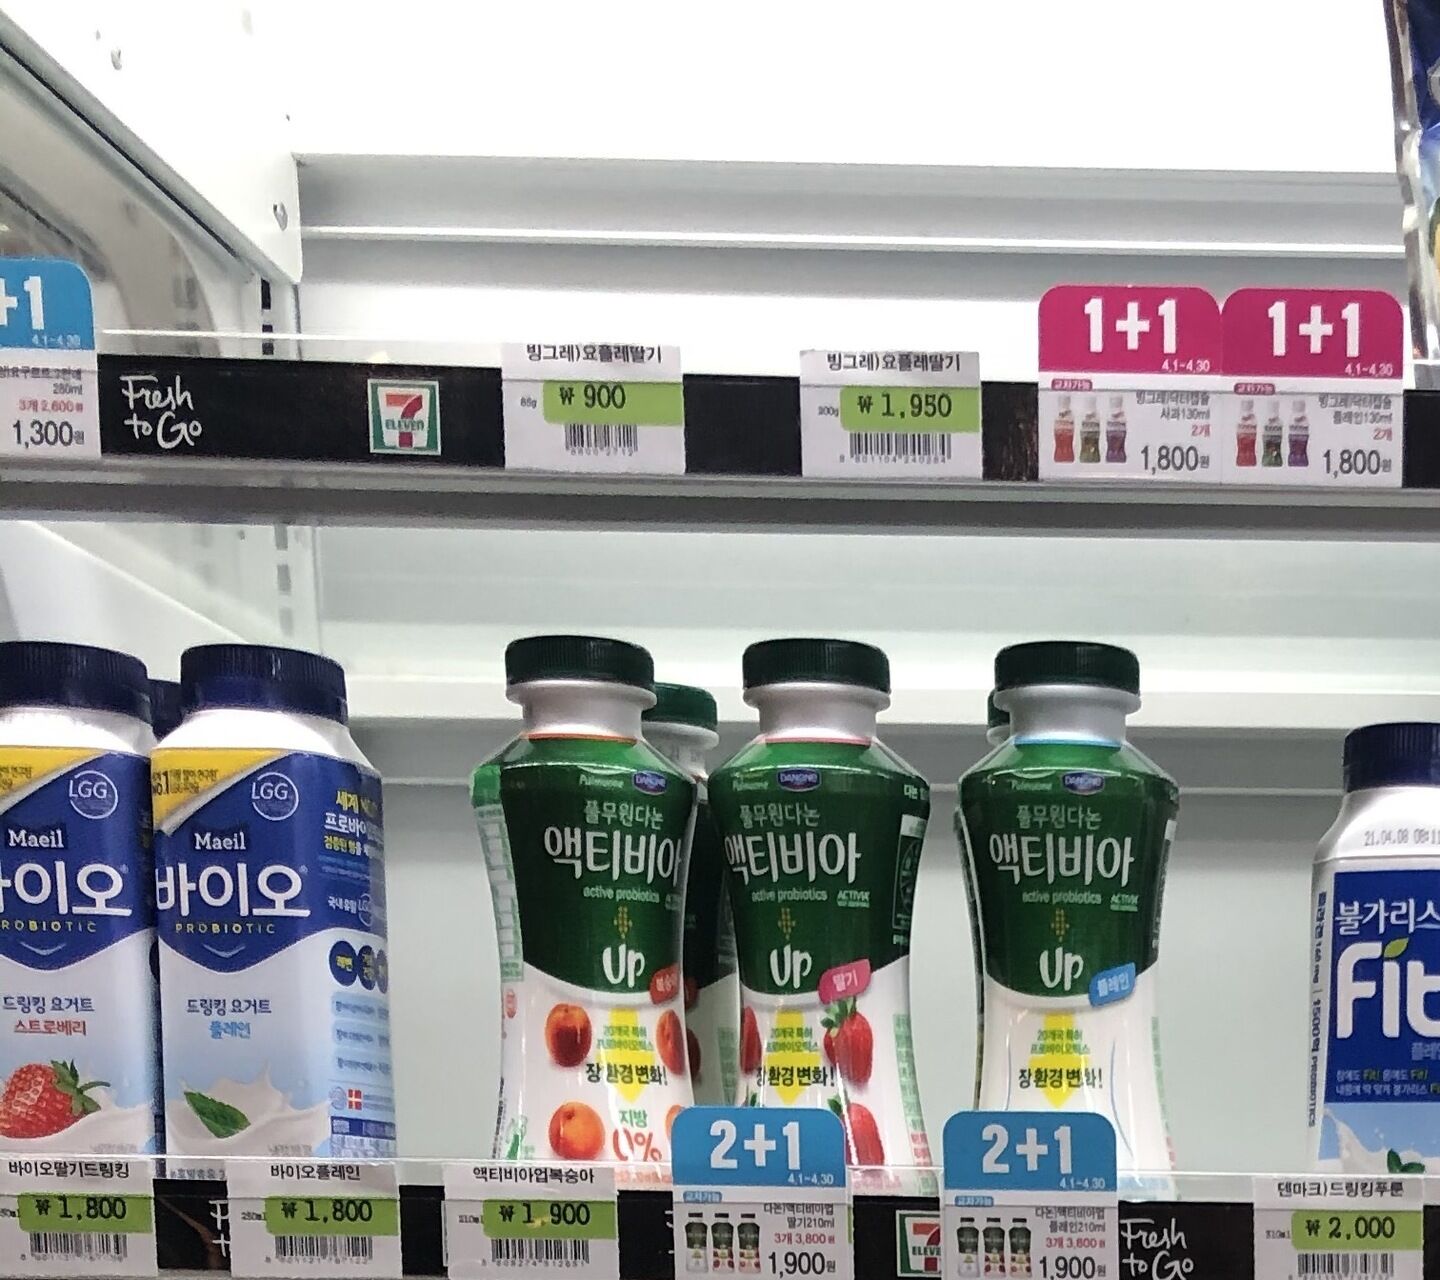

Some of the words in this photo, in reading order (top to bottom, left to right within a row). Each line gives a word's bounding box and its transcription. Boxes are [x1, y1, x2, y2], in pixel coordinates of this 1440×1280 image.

[1084, 298, 1177, 354] 1+1
[1267, 302, 1360, 359] 1+1
[827, 352, 961, 374] 빙그레)요플레딸기
[120, 374, 194, 410] Fresh
[584, 384, 625, 408] 900
[881, 393, 952, 419] 1,950
[12, 419, 85, 447] 1,300원
[124, 417, 153, 440] to
[156, 416, 201, 447] Go
[1141, 444, 1210, 471] 1,800원
[251, 780, 289, 802] LGG
[194, 833, 246, 852] Maeil
[725, 832, 862, 883] 액티비아
[990, 833, 1135, 885] 액티비아
[156, 864, 311, 918] 바이오
[176, 922, 275, 935] PROBIOTIC
[832, 973, 858, 989] 딸기
[14, 1018, 87, 1037] 스트로베리
[209, 1021, 252, 1039] 플레인
[710, 1121, 802, 1172] 2+1
[982, 1124, 1073, 1173] 2+1
[8, 1161, 130, 1179] 바이오딸기드링킹
[270, 1163, 361, 1181] 바이오플레인
[472, 1167, 595, 1183] 액티비아업복숭아
[1329, 1215, 1395, 1239] 2,000
[768, 1251, 836, 1275] 1,900원
